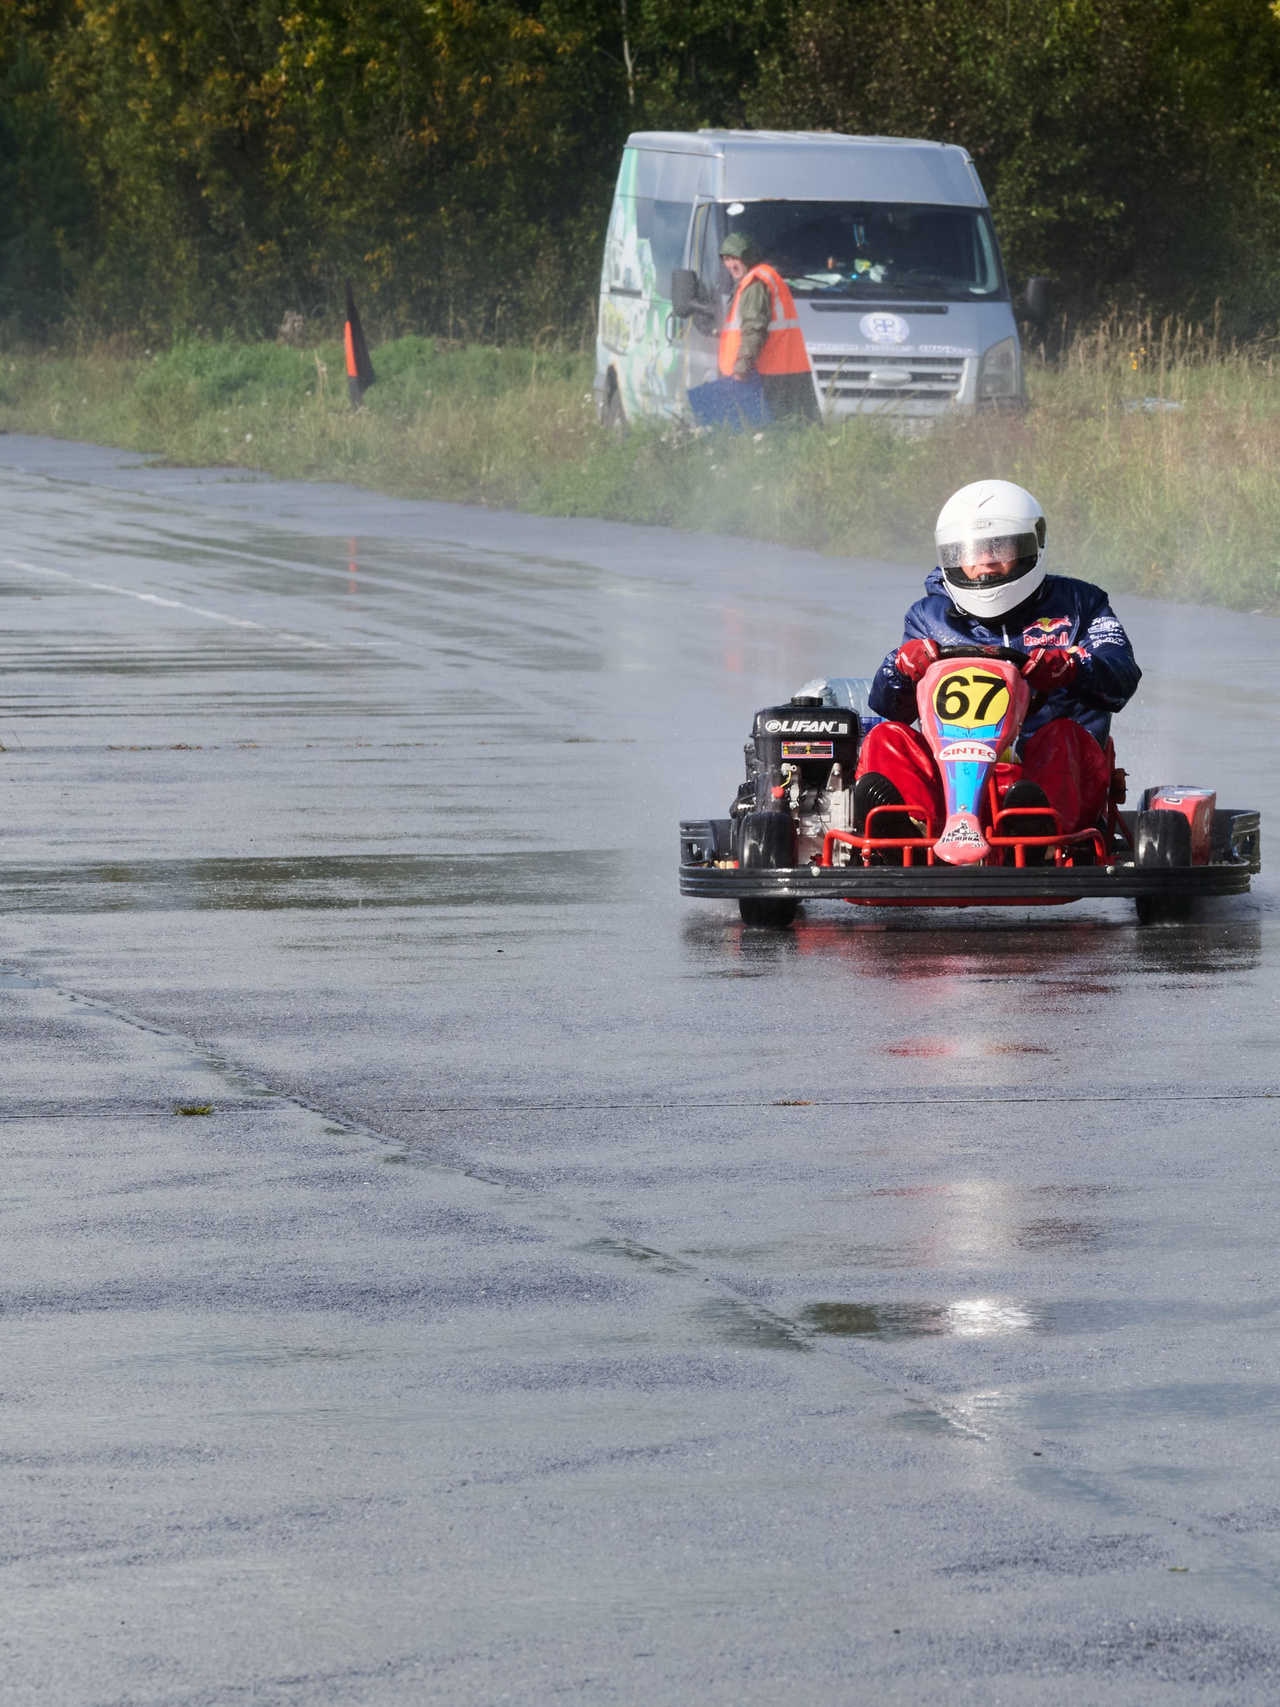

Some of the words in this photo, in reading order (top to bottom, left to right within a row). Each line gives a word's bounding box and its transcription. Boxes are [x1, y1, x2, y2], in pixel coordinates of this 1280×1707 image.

[1023, 634, 1047, 647] Red
[1047, 631, 1069, 647] Bull
[936, 675, 1006, 720] 67
[781, 720, 834, 733] LIFAN
[942, 747, 996, 761] SINTEC
